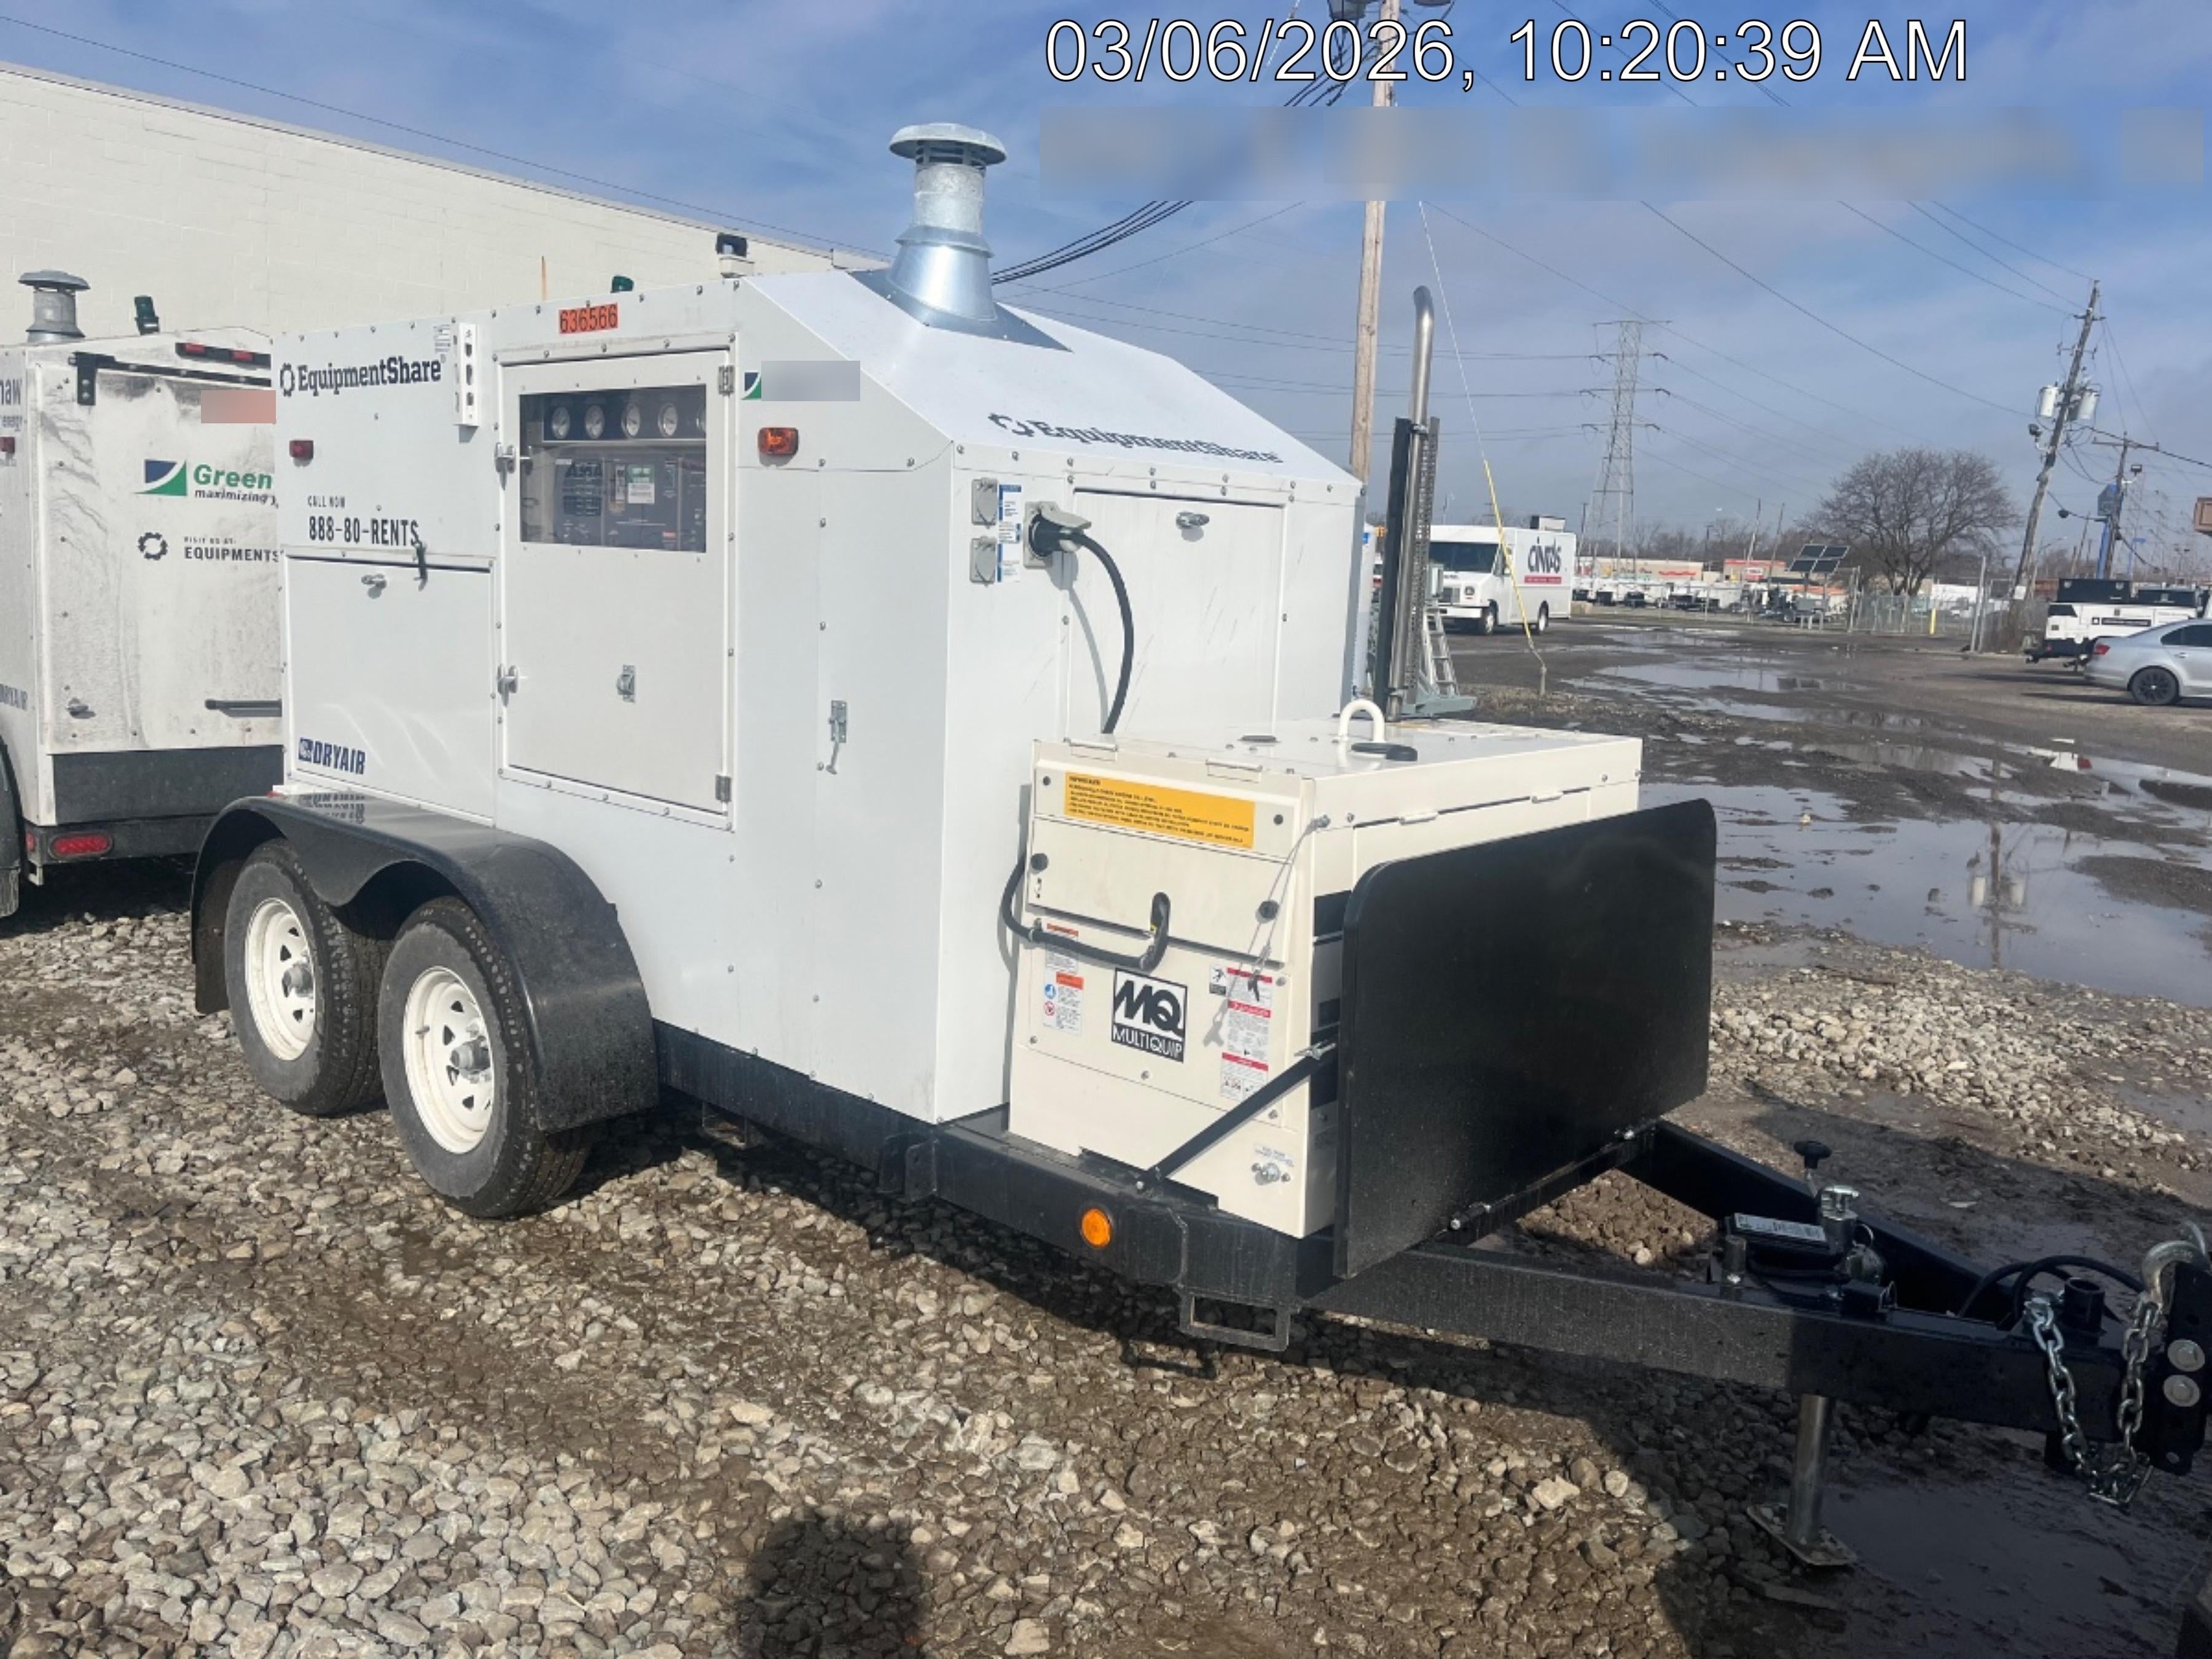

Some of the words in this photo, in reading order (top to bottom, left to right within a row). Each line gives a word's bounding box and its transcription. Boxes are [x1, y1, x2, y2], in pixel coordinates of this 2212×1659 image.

[560, 304, 618, 332] 636566
[297, 356, 441, 396] EquipmentShare
[1027, 420, 1281, 462] EquipmentShare
[193, 465, 273, 489] Green
[308, 495, 326, 507] CALL
[329, 496, 345, 508] NOW
[309, 516, 419, 546] 888-80-RENTS
[313, 740, 366, 775] DRYAIR
[1115, 980, 1184, 1038] MQ
[1113, 1024, 1182, 1057] MULTIQUIP
